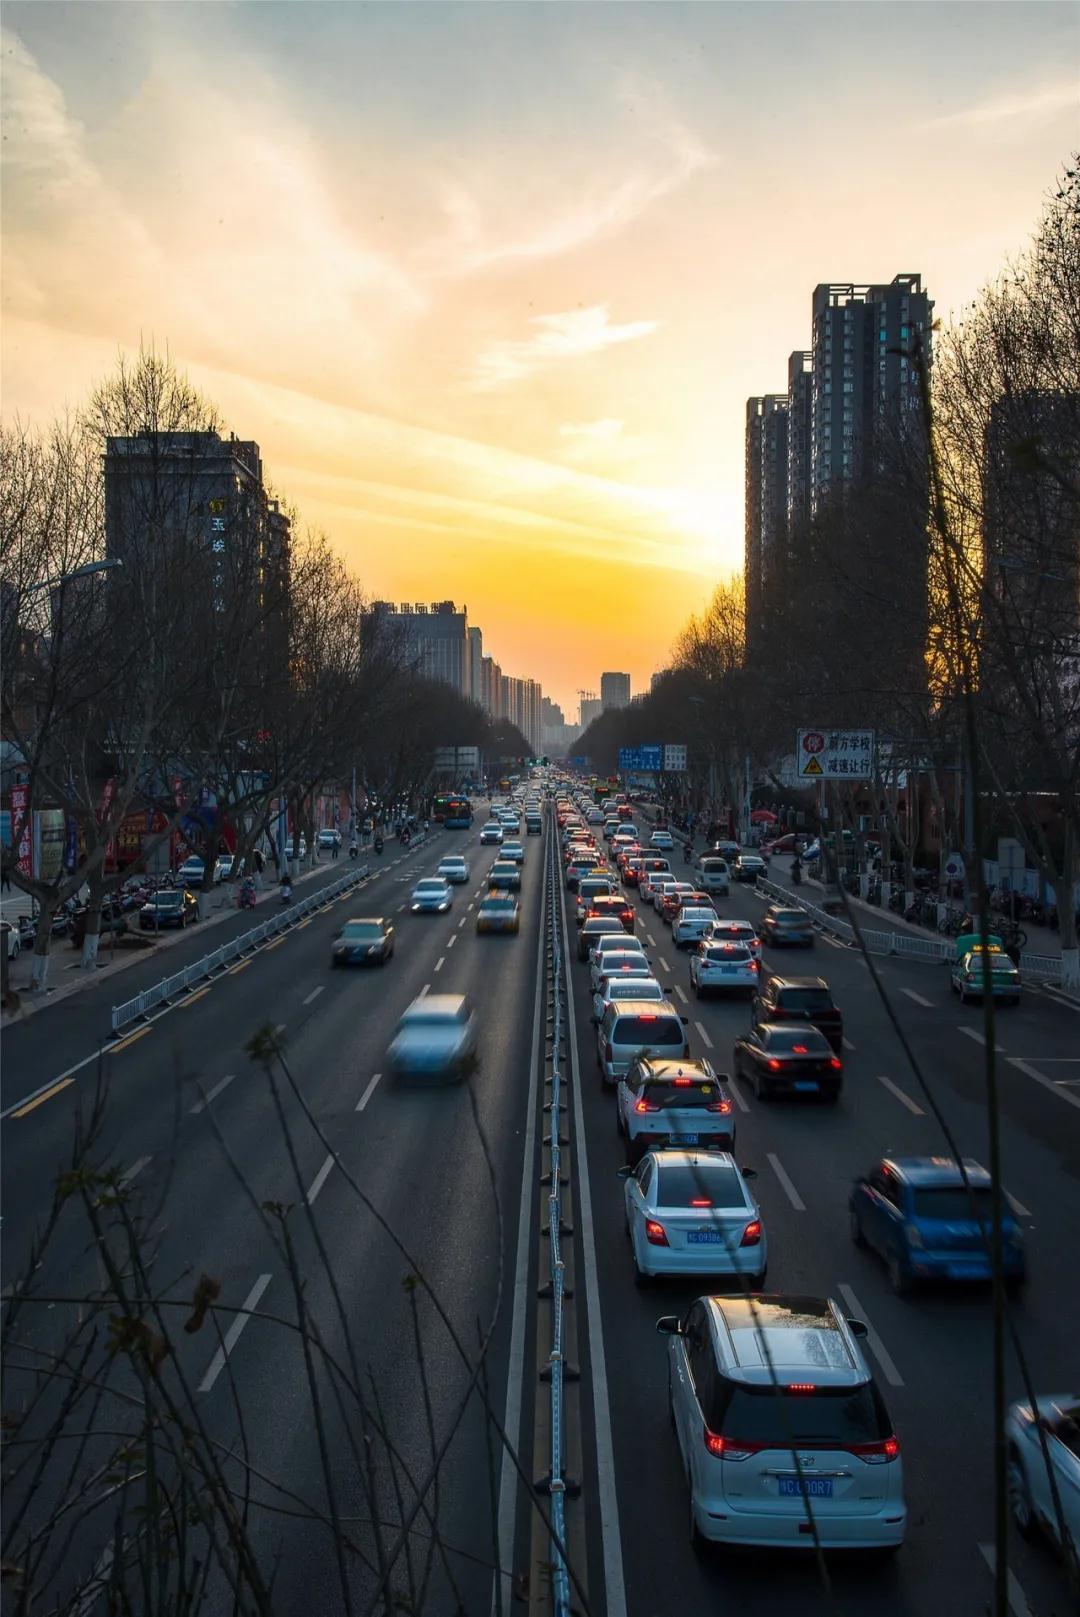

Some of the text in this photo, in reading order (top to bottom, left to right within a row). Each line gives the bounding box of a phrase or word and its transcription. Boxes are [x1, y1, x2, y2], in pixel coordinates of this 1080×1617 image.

[807, 736, 822, 752] 停
[828, 735, 870, 751] 前方学校
[828, 758, 871, 773] 减速让行
